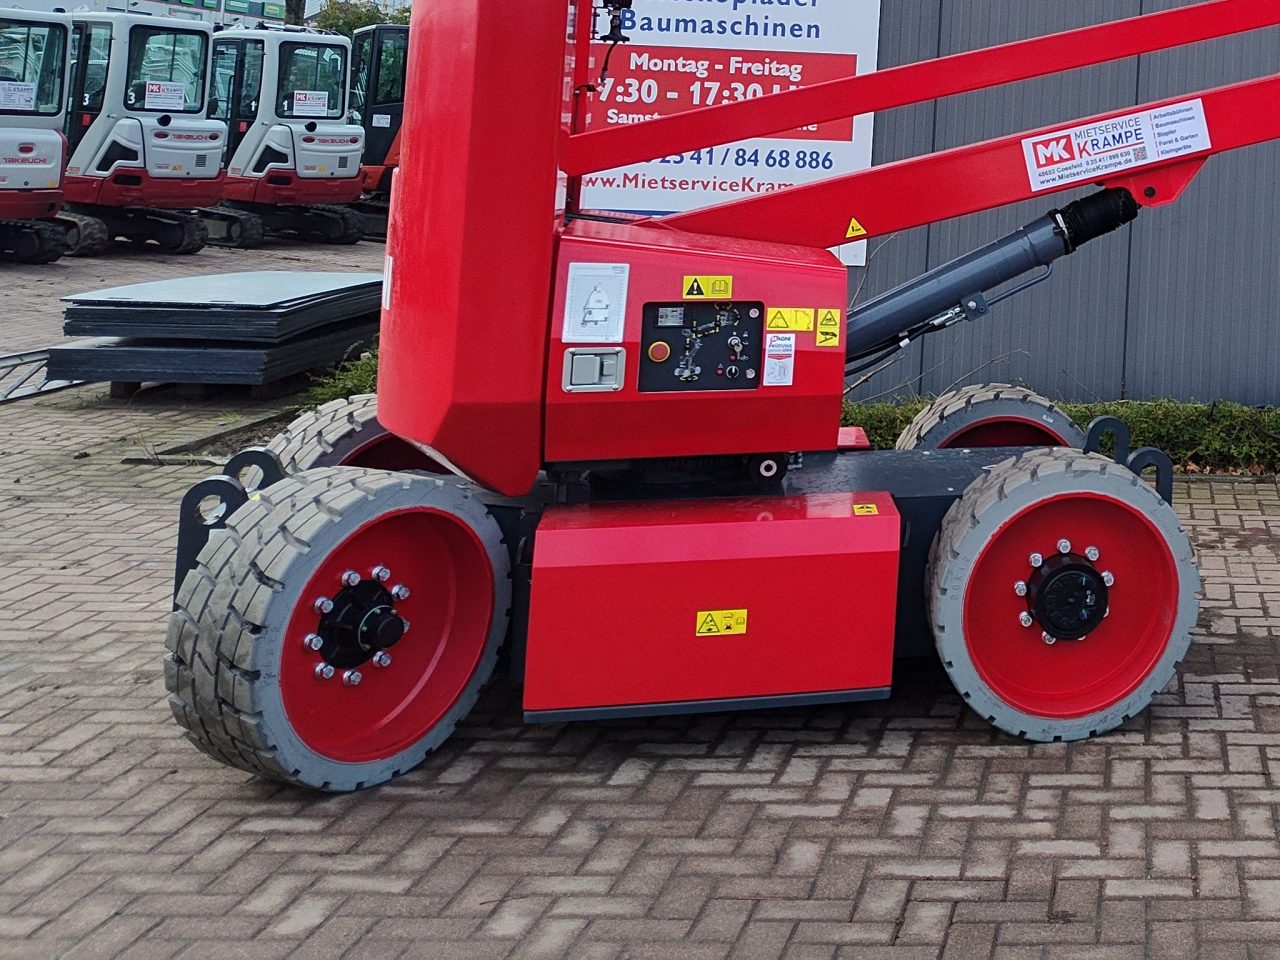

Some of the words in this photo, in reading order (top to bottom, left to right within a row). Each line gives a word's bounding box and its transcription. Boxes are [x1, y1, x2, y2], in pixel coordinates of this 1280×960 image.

[620, 8, 820, 39] Baumaschinen
[629, 52, 710, 78] Montag
[729, 56, 803, 82] Freitag
[597, 76, 659, 104] 7:30
[689, 81, 763, 106] 17:30
[1036, 138, 1071, 165] MK
[1074, 117, 1141, 140] MIETSERVICE
[1076, 128, 1144, 158] KRAMPE
[734, 148, 759, 167] 84
[765, 149, 790, 168] 68
[795, 150, 833, 170] 886
[1039, 158, 1133, 185] www.MietserviceKrampe.de
[1056, 162, 1083, 173] Coesfeld
